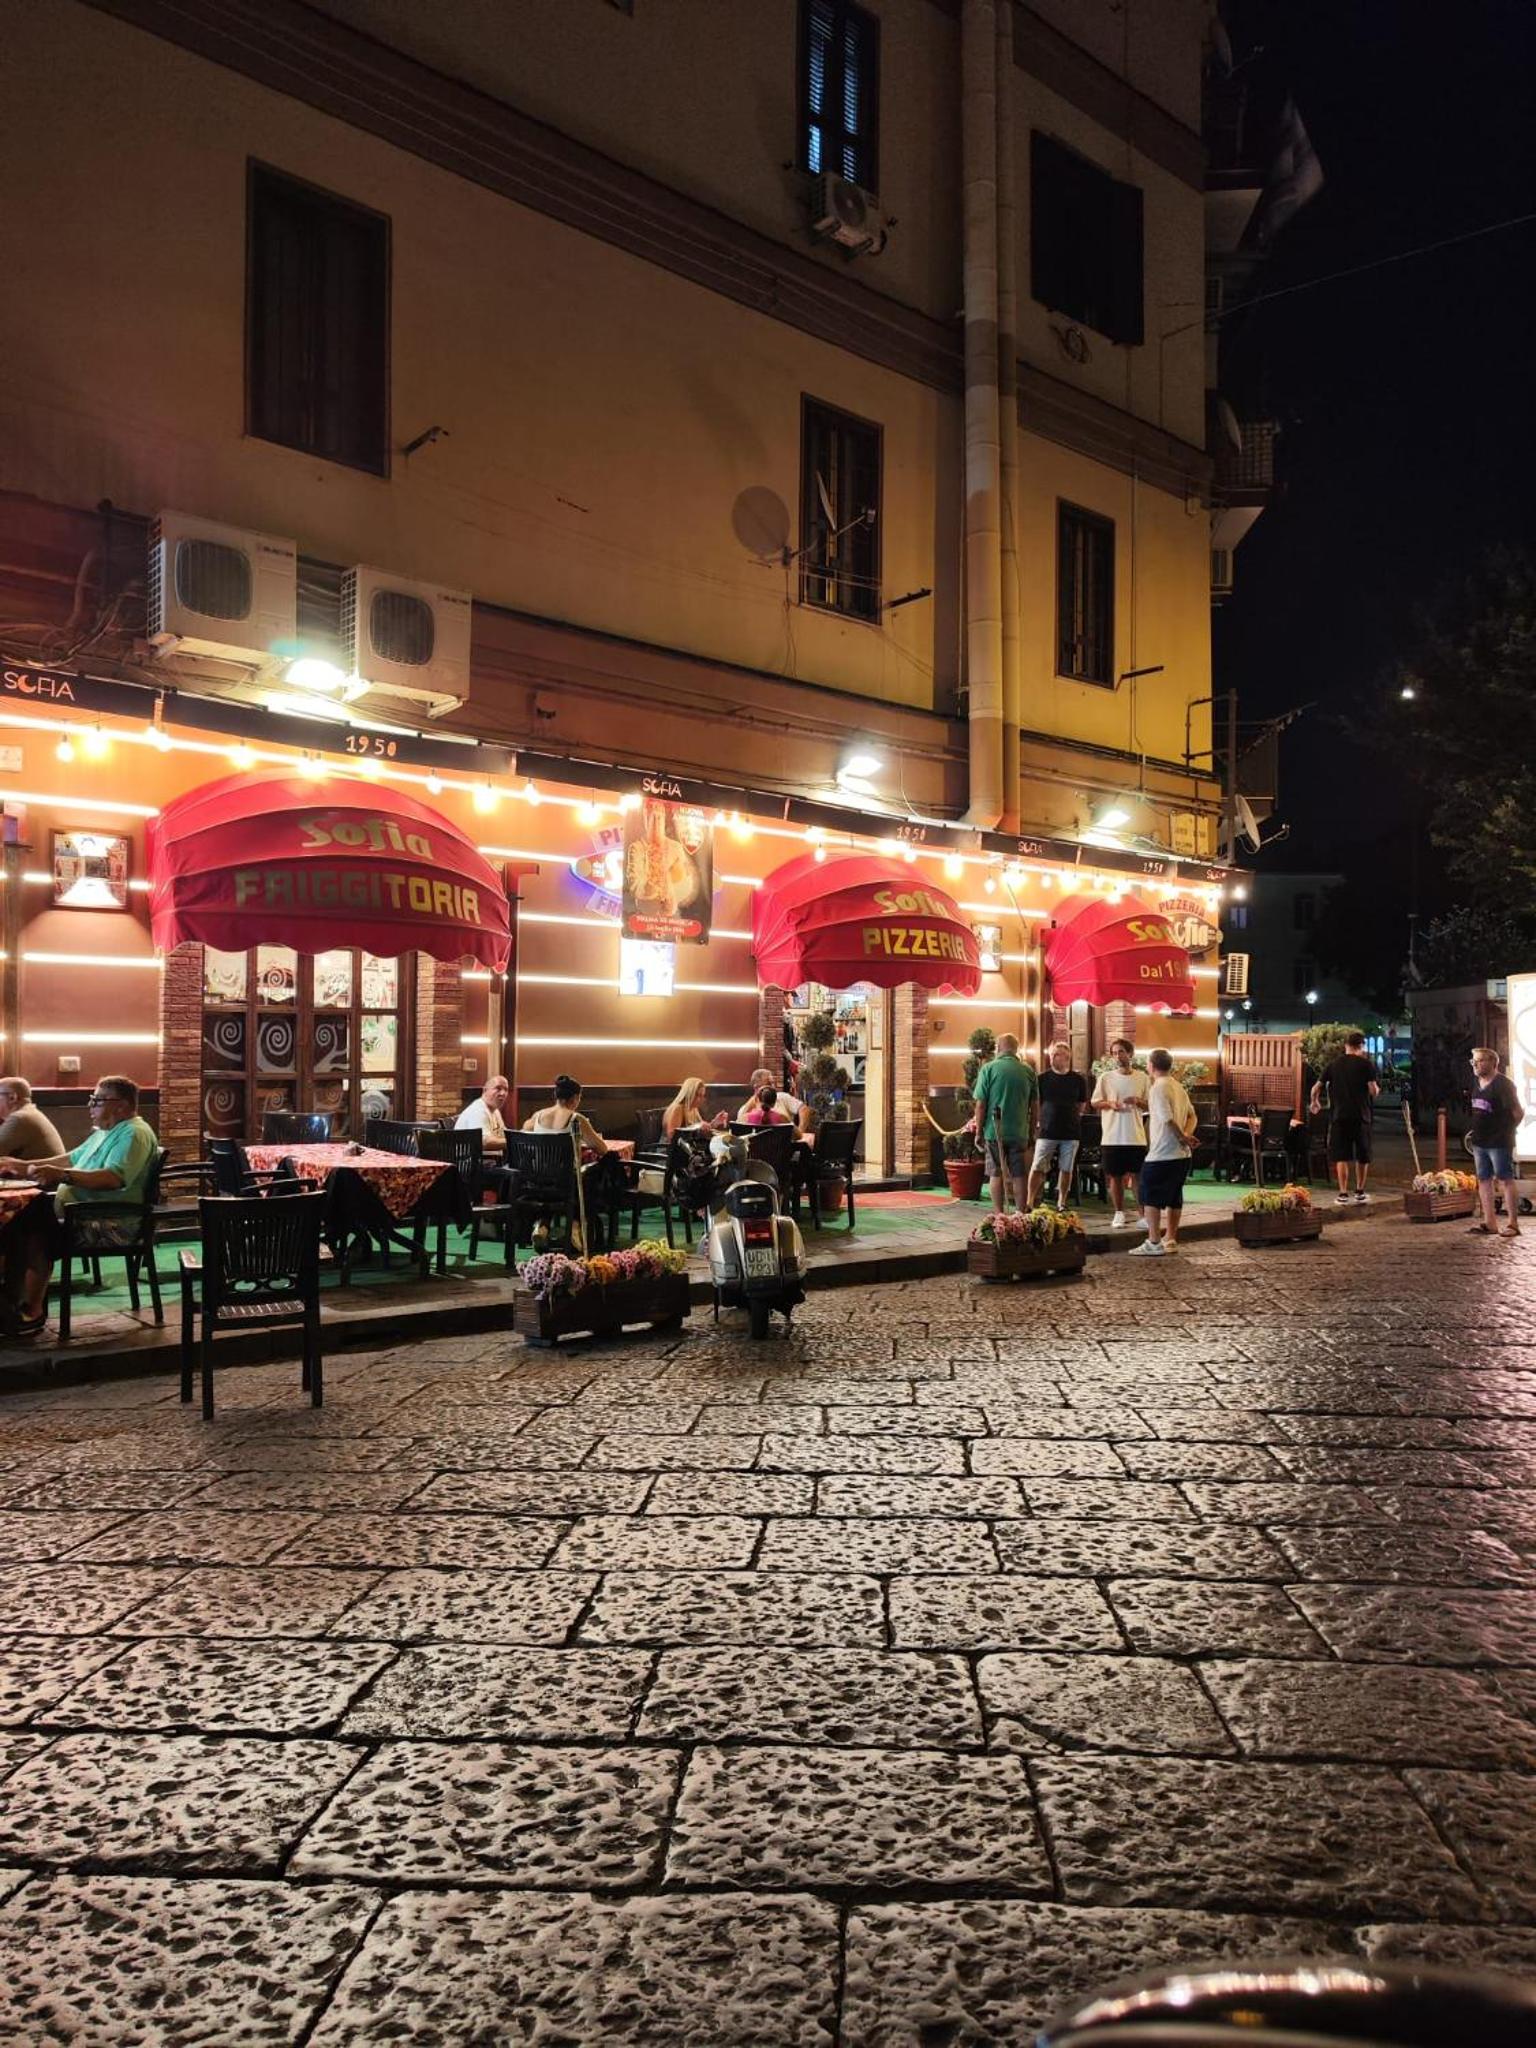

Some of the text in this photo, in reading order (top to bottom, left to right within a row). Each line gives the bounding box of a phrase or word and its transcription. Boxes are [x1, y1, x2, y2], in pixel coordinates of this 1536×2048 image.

[3, 671, 76, 702] SOFIA
[345, 735, 397, 757] 1950
[641, 777, 682, 798] SOFIA
[298, 814, 432, 861] Sofia
[234, 868, 482, 924] FRIGGITORIA
[872, 888, 957, 920] Sofia
[1158, 898, 1206, 917] PIZZERIA
[862, 926, 969, 961] PIZZERIA
[1140, 964, 1163, 978] Dal
